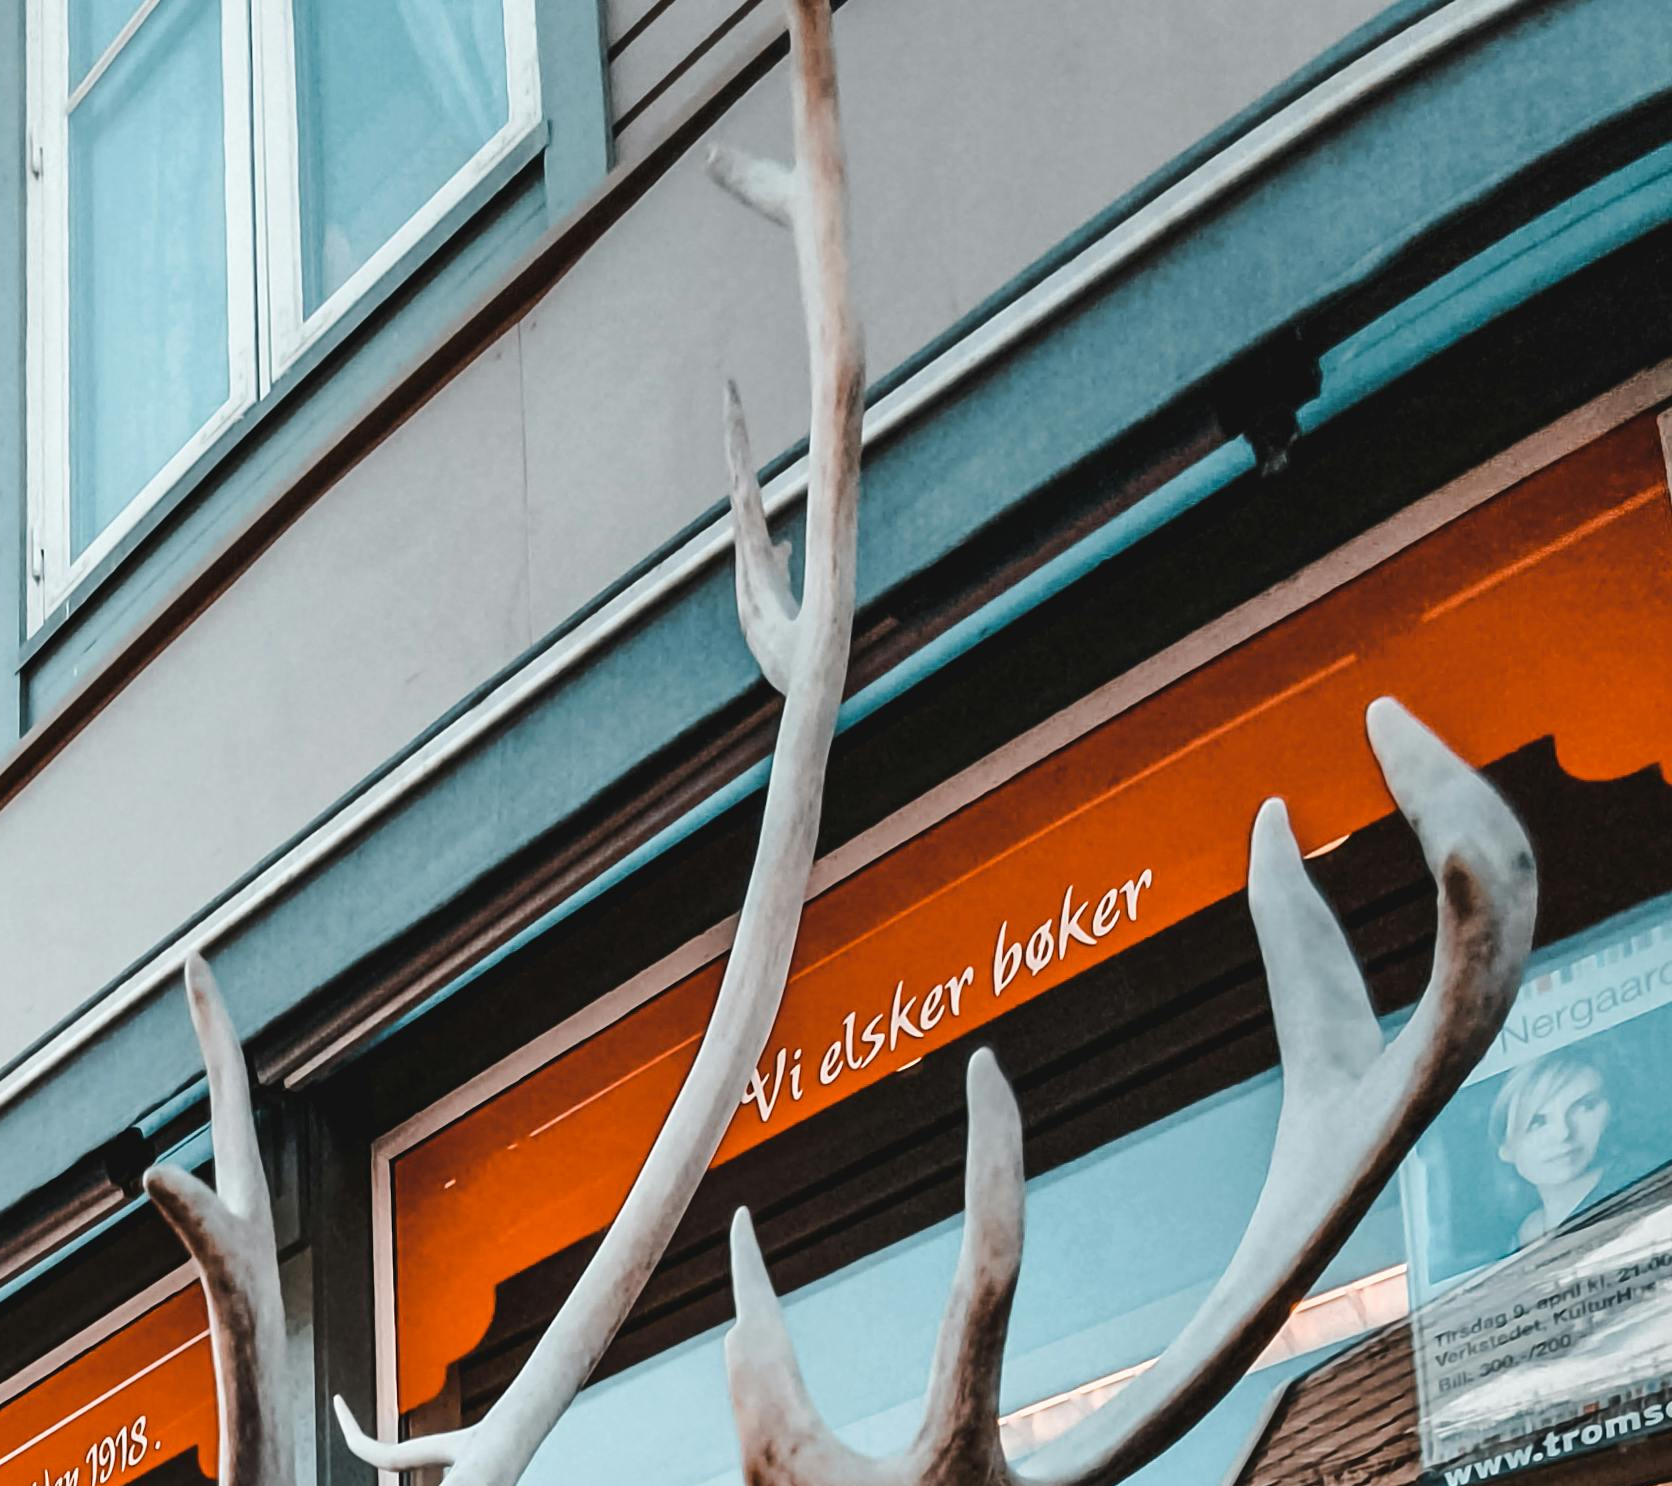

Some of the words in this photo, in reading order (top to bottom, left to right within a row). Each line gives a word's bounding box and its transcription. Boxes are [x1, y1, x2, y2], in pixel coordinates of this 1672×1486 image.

[741, 1046, 803, 1122] Vi
[819, 966, 975, 1085] elsker
[992, 868, 1153, 998] bøker
